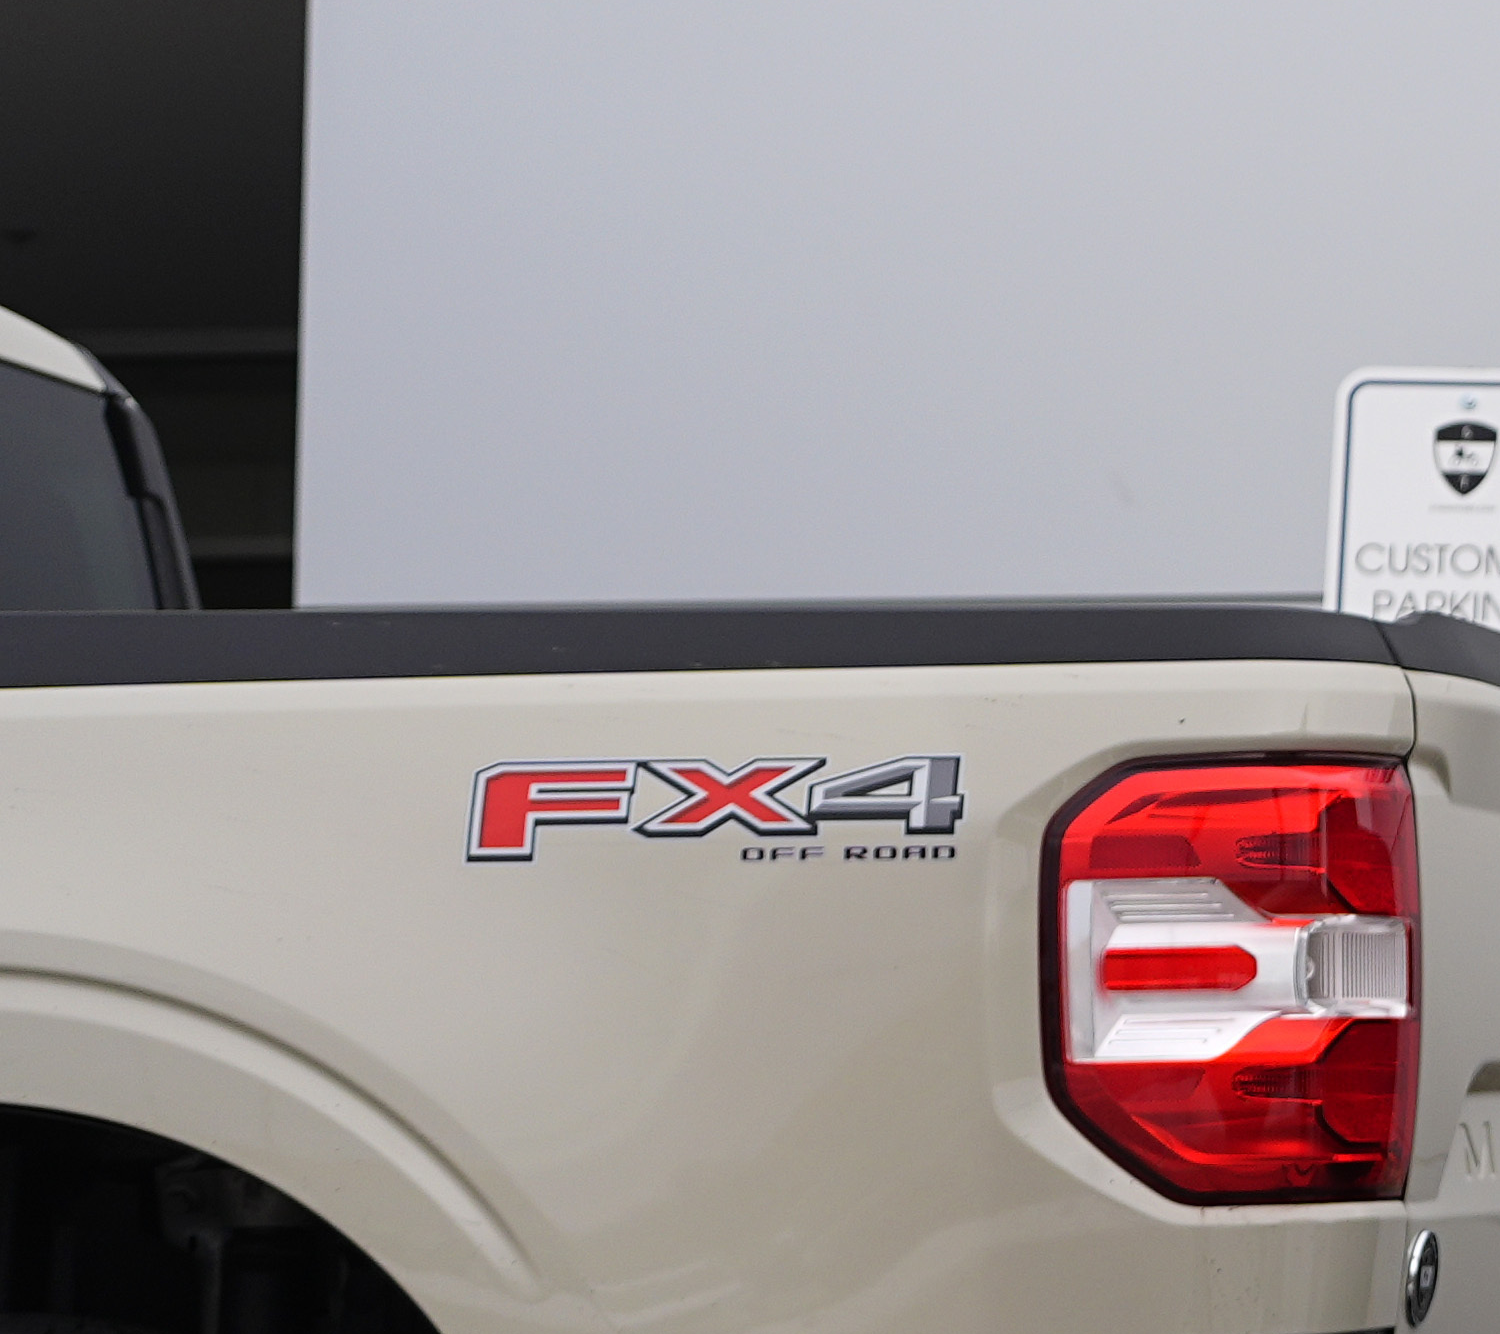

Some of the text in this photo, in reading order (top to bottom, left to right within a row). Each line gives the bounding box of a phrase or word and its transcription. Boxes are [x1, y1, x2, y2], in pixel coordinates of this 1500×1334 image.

[466, 755, 964, 862] FX4
[741, 845, 955, 861] OFF ROAD
